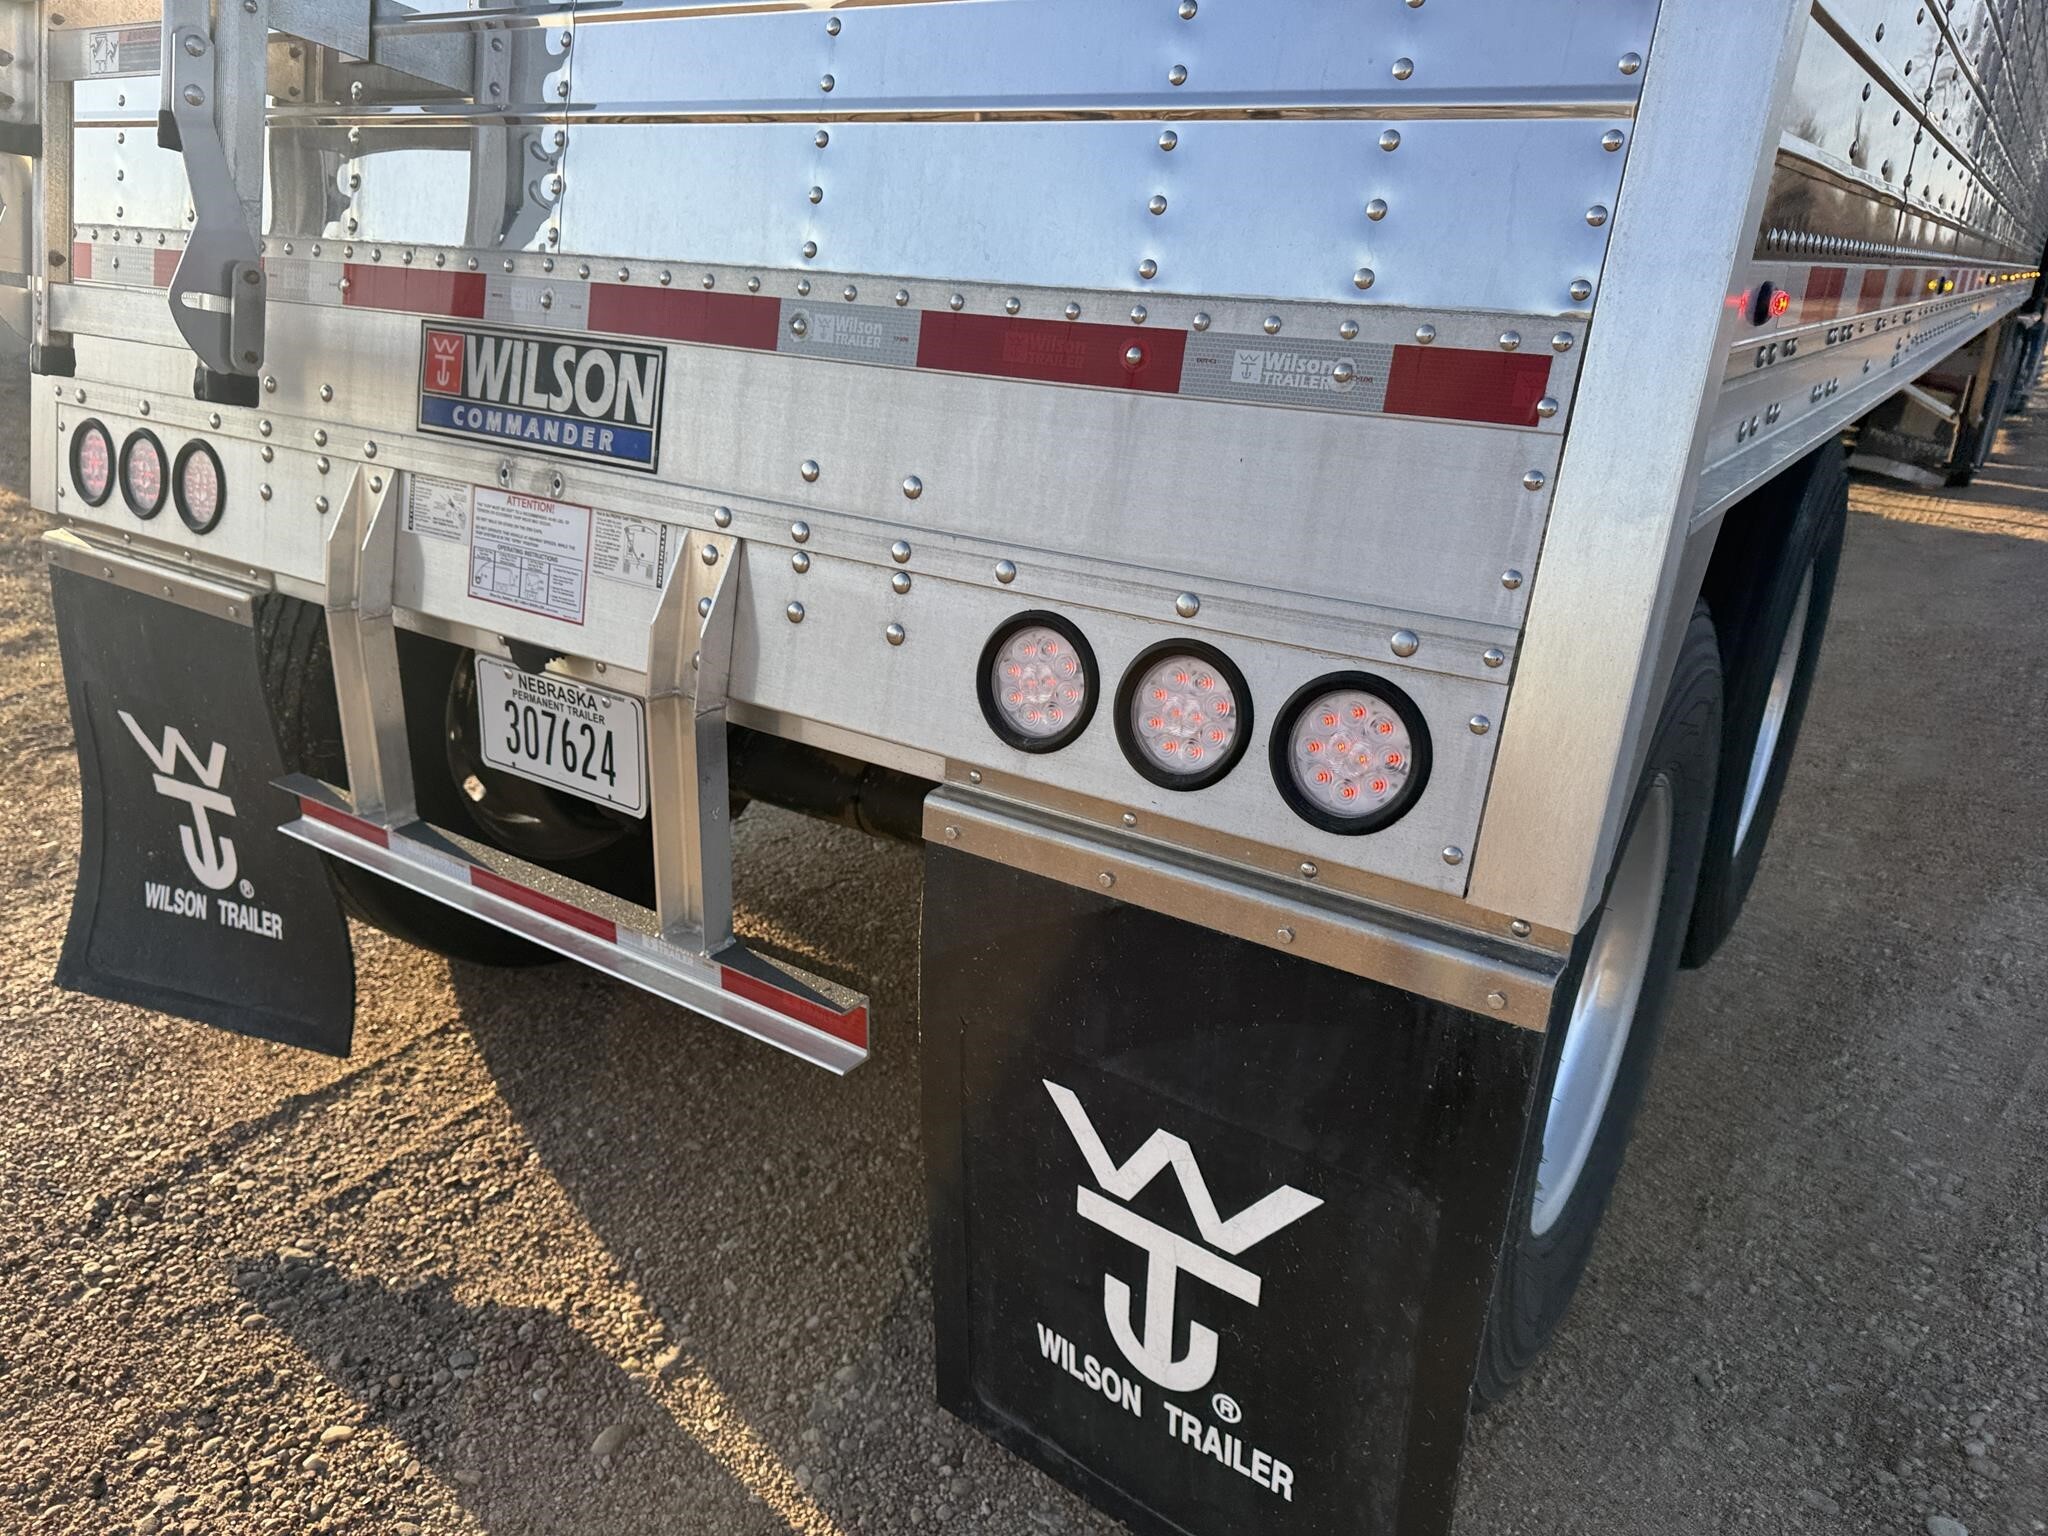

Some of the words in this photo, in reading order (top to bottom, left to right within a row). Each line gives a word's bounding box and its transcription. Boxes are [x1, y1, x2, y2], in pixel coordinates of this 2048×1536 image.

[835, 315, 882, 335] Wilson
[835, 333, 880, 348] TRAILER
[467, 335, 658, 425] WILSON
[1264, 352, 1333, 374] Wilson
[1264, 371, 1330, 390] TRAILER
[453, 405, 614, 451] COMMANDER
[506, 496, 555, 513] ATTENTION!
[512, 689, 565, 713] PERMANENT
[567, 706, 605, 725] TRAILER
[518, 674, 598, 711] NEBRASKA
[505, 700, 616, 787] 307624
[145, 881, 207, 920] WILSON
[218, 899, 283, 940] TRAILER
[1037, 1322, 1141, 1417] WILSON
[1163, 1401, 1294, 1501] TRAILER
